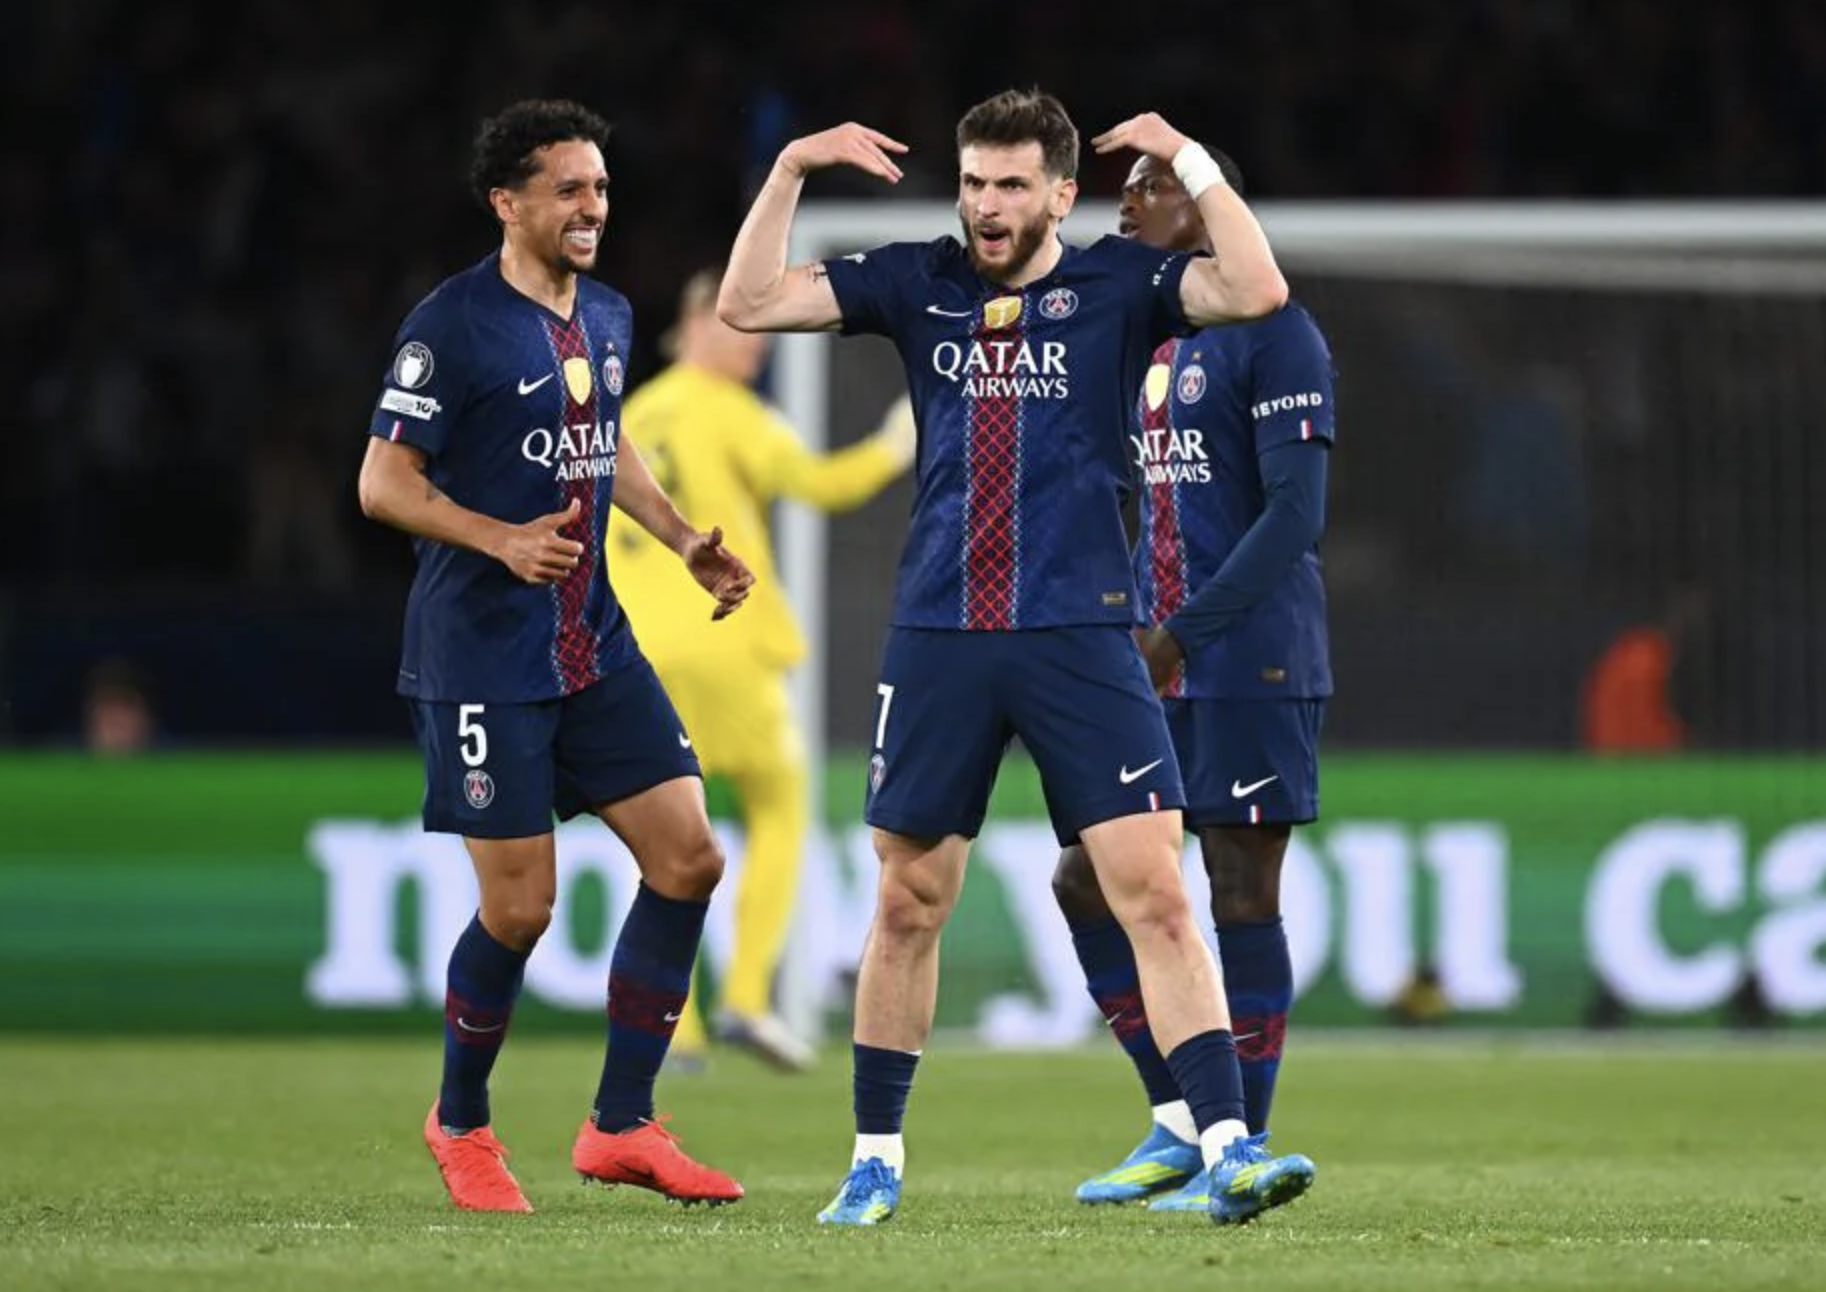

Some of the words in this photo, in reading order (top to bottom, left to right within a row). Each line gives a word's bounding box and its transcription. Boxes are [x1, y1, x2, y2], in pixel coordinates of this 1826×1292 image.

[933, 341, 1068, 382] QATAR
[961, 377, 1069, 399] AIRWAYS
[521, 421, 617, 468] QATAR
[555, 455, 617, 481] AIRWAYS
[458, 704, 488, 767] 5
[875, 683, 895, 749] 7
